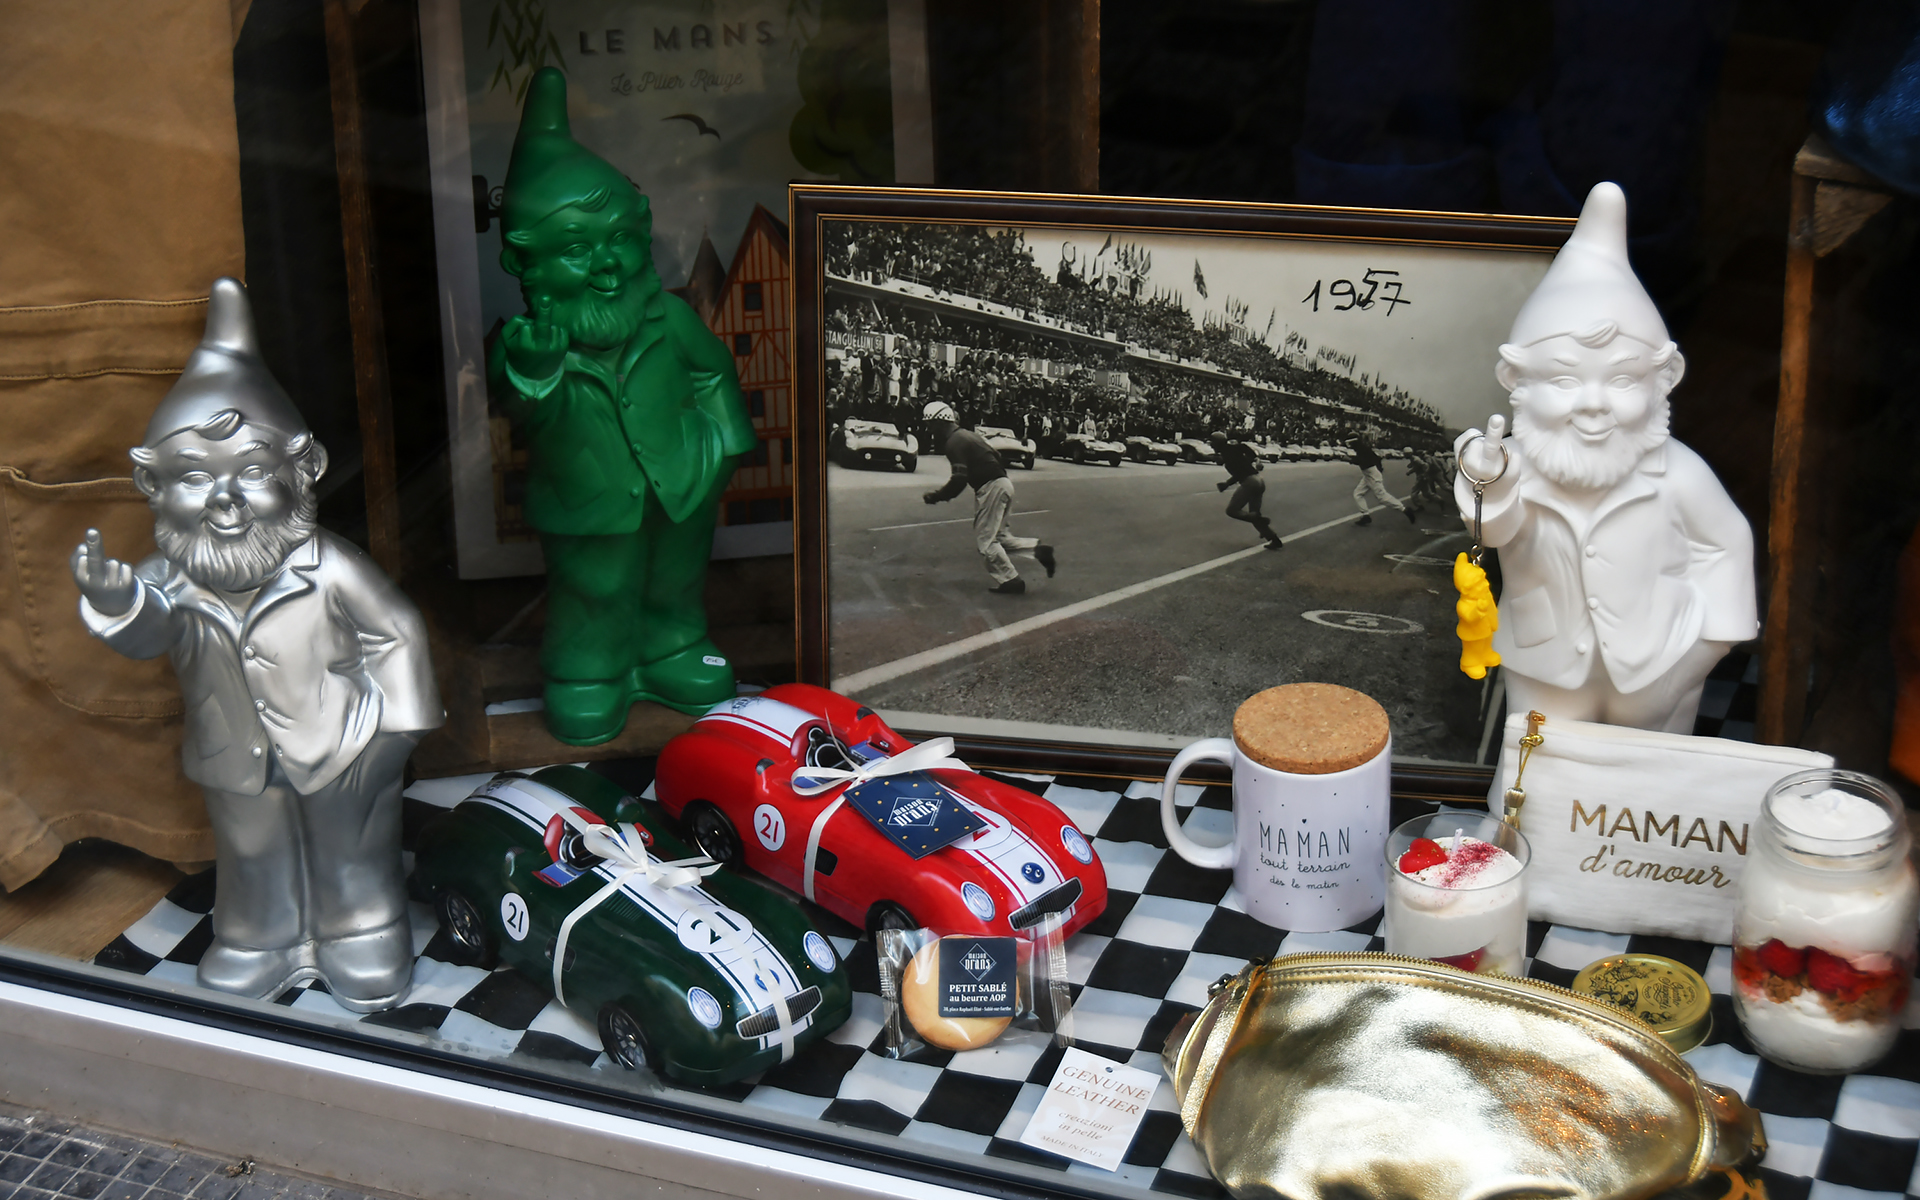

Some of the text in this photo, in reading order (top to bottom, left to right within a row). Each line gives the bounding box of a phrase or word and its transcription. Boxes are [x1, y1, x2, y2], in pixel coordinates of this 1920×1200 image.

[579, 20, 773, 54] LE MANS
[611, 69, 743, 96] Le Pilier Rouge
[760, 812, 779, 843] 21
[1259, 820, 1350, 858] MAMAN
[1570, 799, 1749, 856] MAMAN
[1260, 852, 1350, 873] tout terrain
[1579, 844, 1731, 889] d'amour
[1269, 875, 1339, 890] dès le matin
[506, 901, 524, 933] 21
[949, 981, 1007, 993] PETIT SABLÉ
[961, 994, 988, 1002] beurre
[989, 993, 1007, 1002] AOP
[1062, 1066, 1150, 1101] GENUINE
[1053, 1082, 1140, 1115] LEATHER
[1058, 1111, 1114, 1132] creazioni
[1058, 1122, 1103, 1141] in pelle
[1040, 1135, 1103, 1158] MADE IN ITALY
